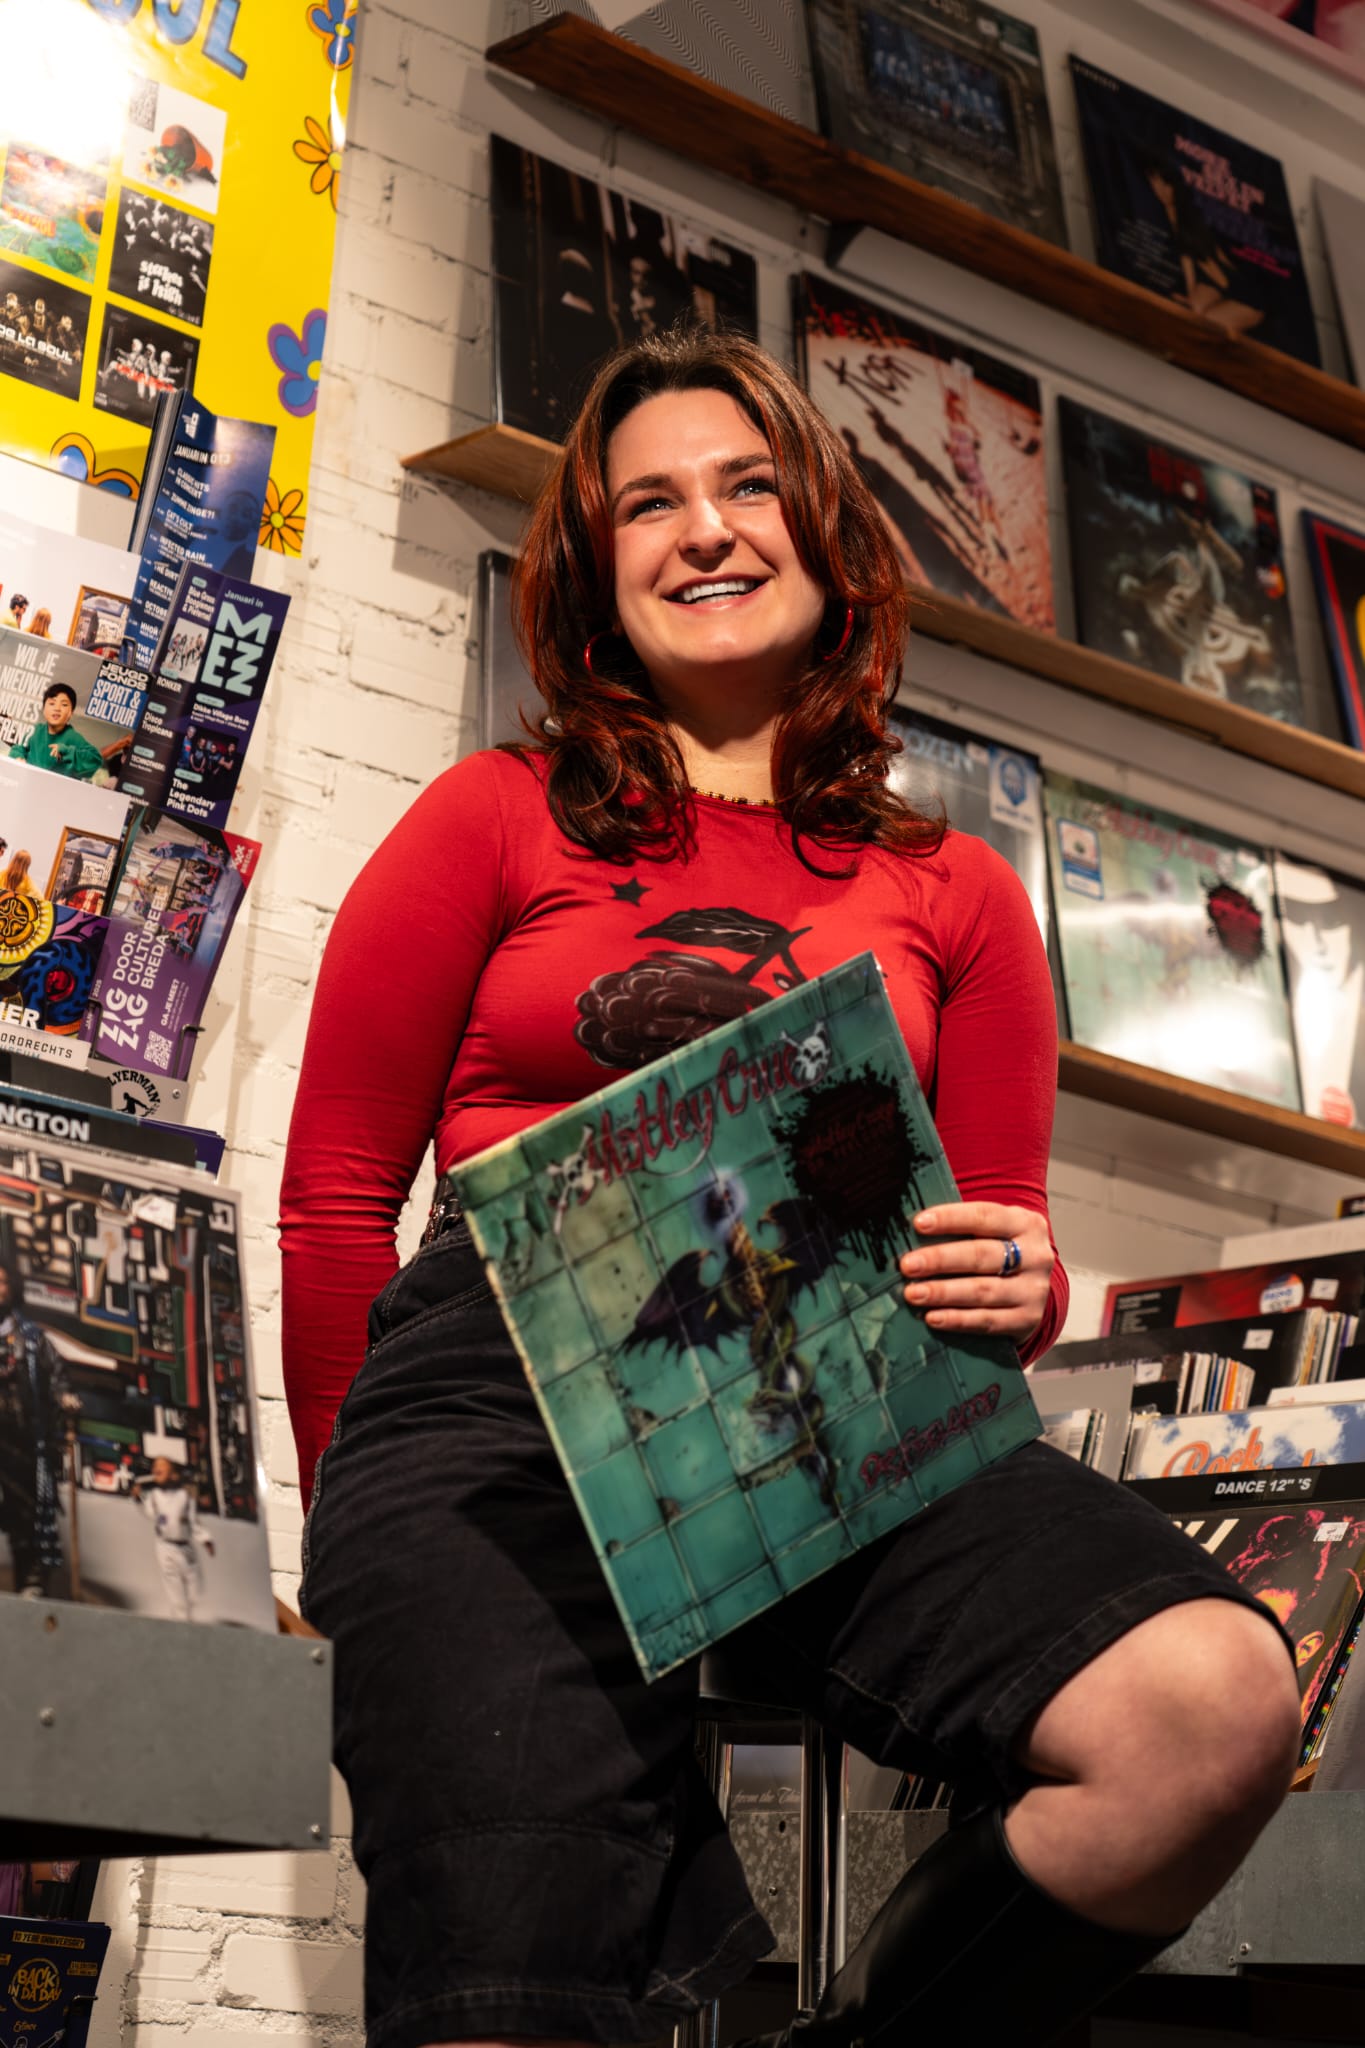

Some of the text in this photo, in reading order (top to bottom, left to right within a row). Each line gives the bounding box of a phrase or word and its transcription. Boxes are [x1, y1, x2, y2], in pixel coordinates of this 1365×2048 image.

[224, 589, 264, 609] Januari in
[99, 669, 147, 691] FONDS
[102, 660, 149, 683] JEUGD
[93, 678, 142, 710] SPORT &
[87, 696, 138, 728] CULTUUR
[172, 777, 189, 791] The
[166, 798, 208, 818] Pink Dots
[169, 788, 216, 811] Legendary
[112, 931, 139, 982] DOOR
[141, 934, 169, 990] BREDA
[99, 987, 127, 1044] ZIG
[117, 993, 148, 1050] ZAG
[1214, 1480, 1267, 1495] DANCE
[17, 1966, 58, 1989] BACK
[8, 1984, 62, 2002] IN DA DAY
